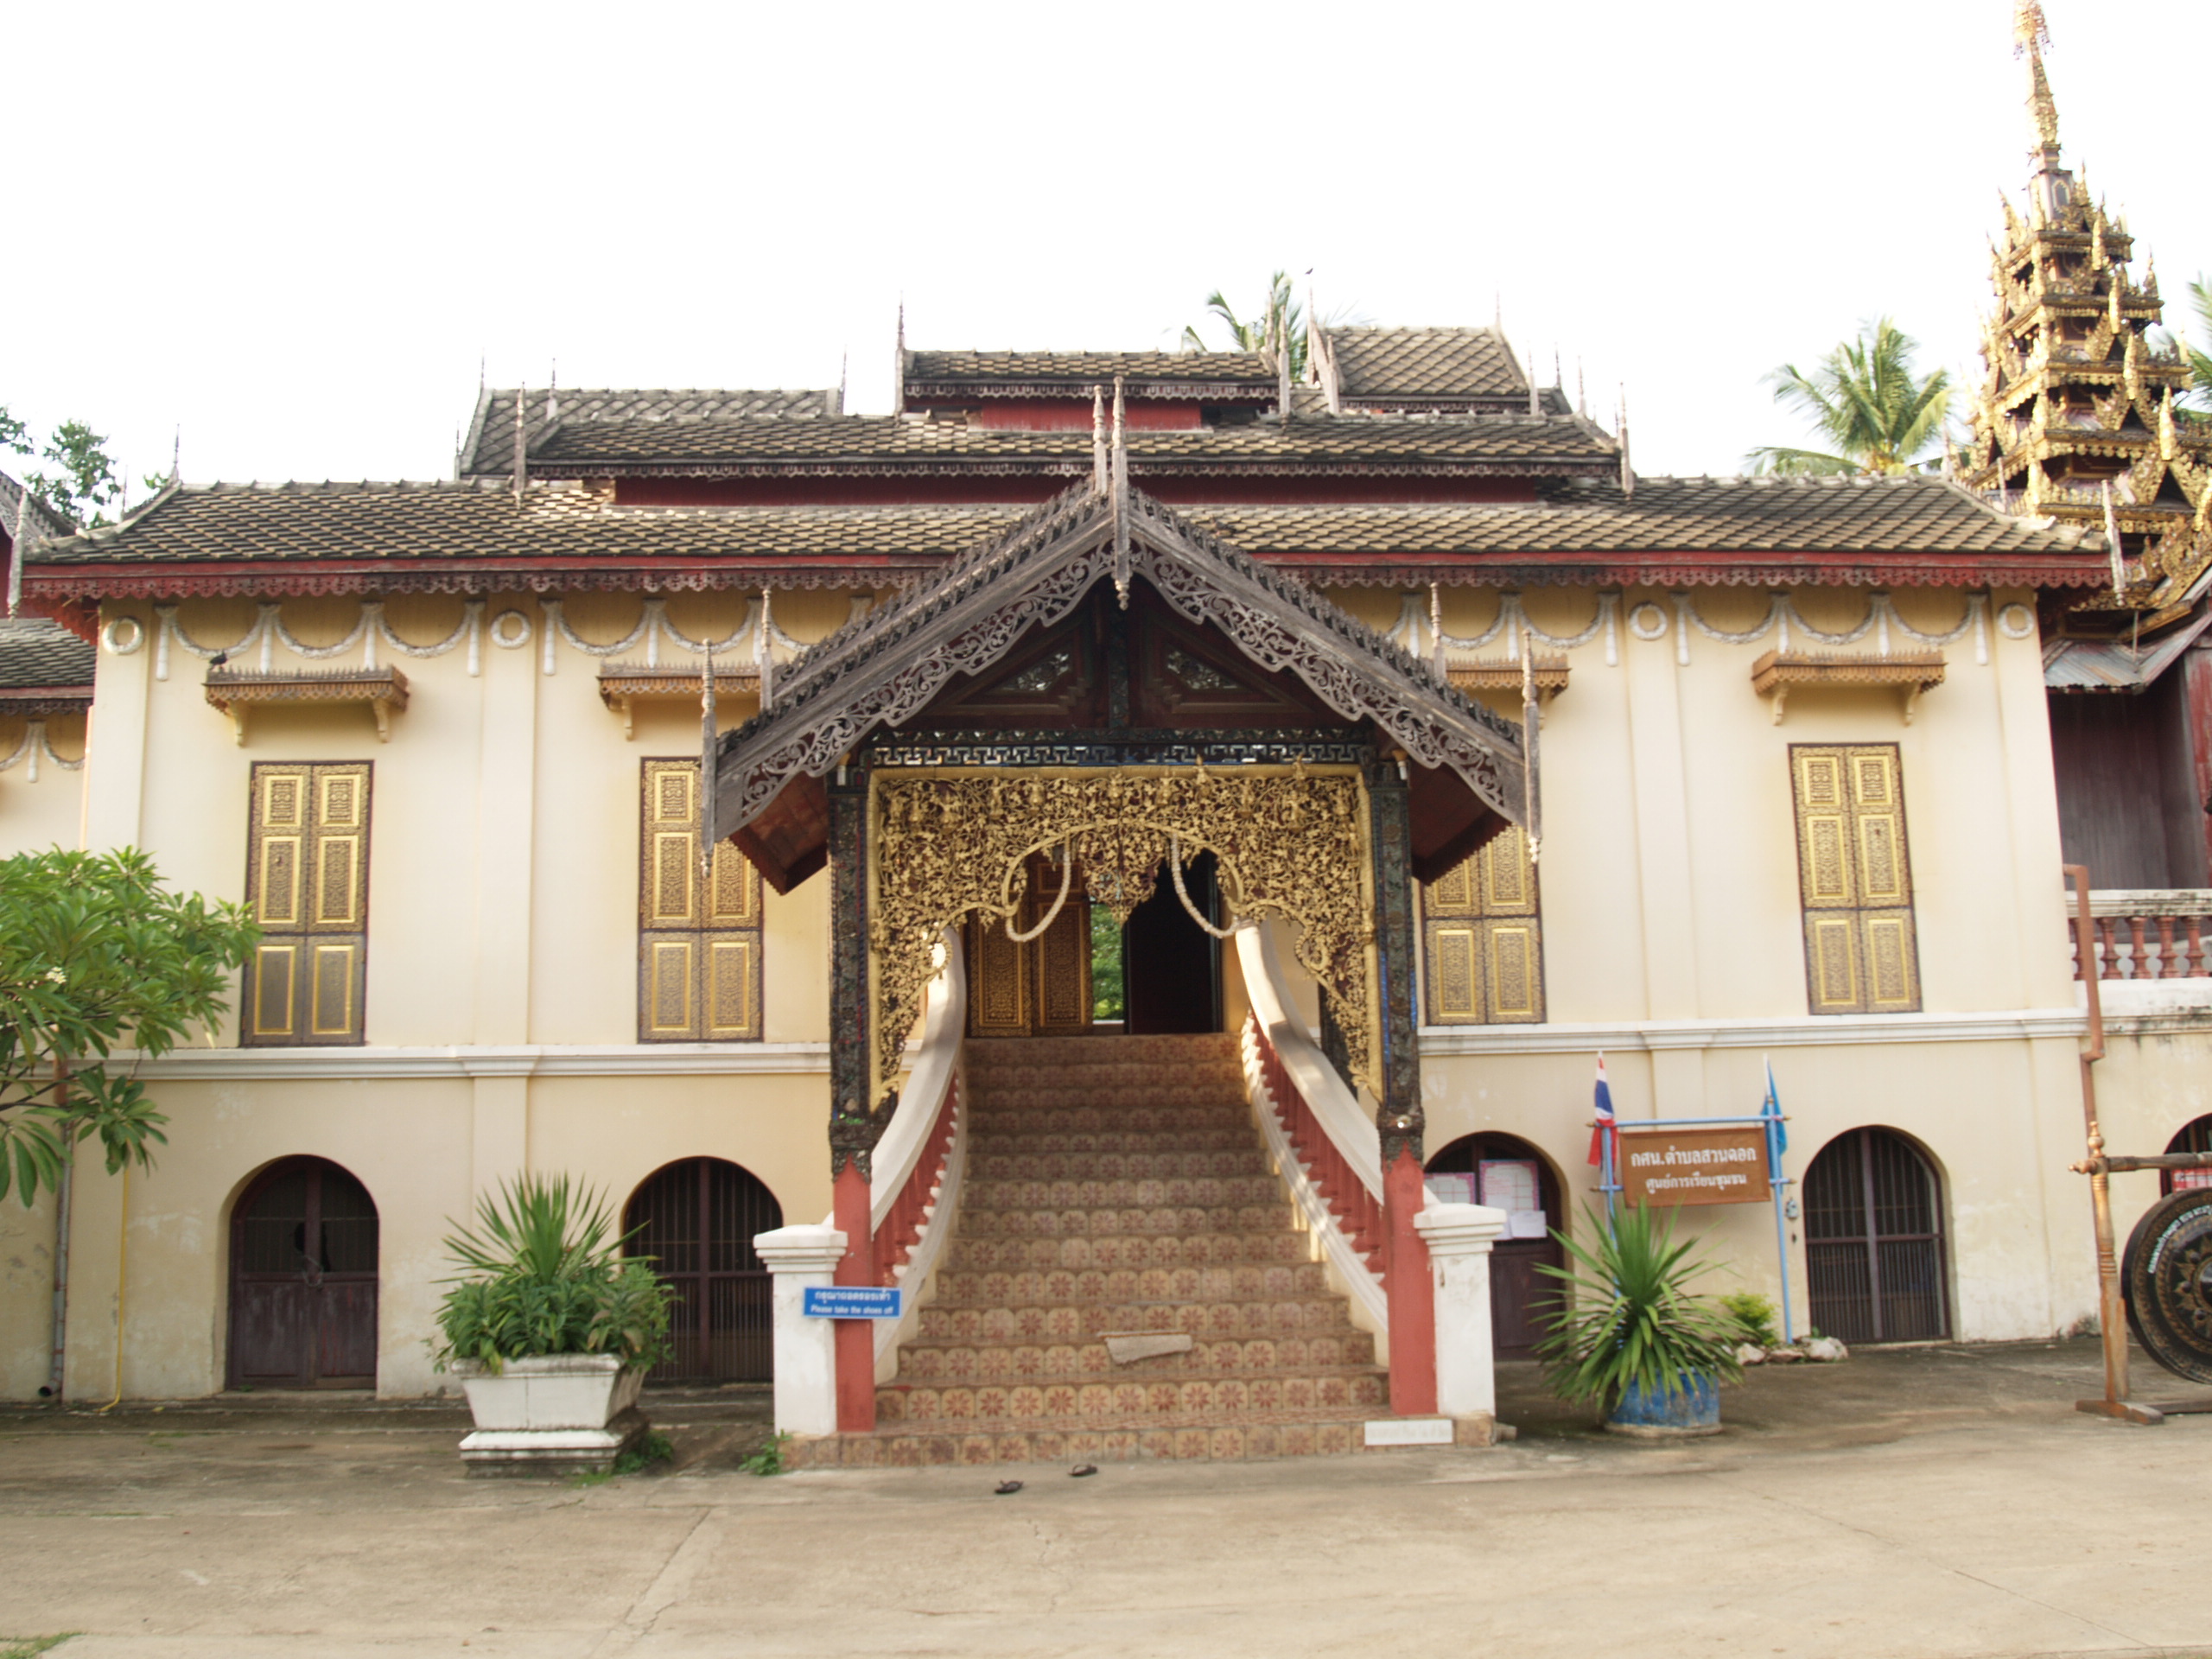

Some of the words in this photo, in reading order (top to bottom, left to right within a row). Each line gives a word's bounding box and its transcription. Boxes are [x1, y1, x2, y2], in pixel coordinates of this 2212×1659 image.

[1630, 1146, 1757, 1167] กศน.ตำบลสวนดอก
[1646, 1172, 1747, 1194] ศูนย์การเรียนชุมชน
[815, 1289, 891, 1304] กรุณาถอดรองเท้า
[811, 1306, 832, 1314] Please
[835, 1306, 849, 1314] take
[850, 1306, 861, 1314] the
[863, 1306, 882, 1314] shoes
